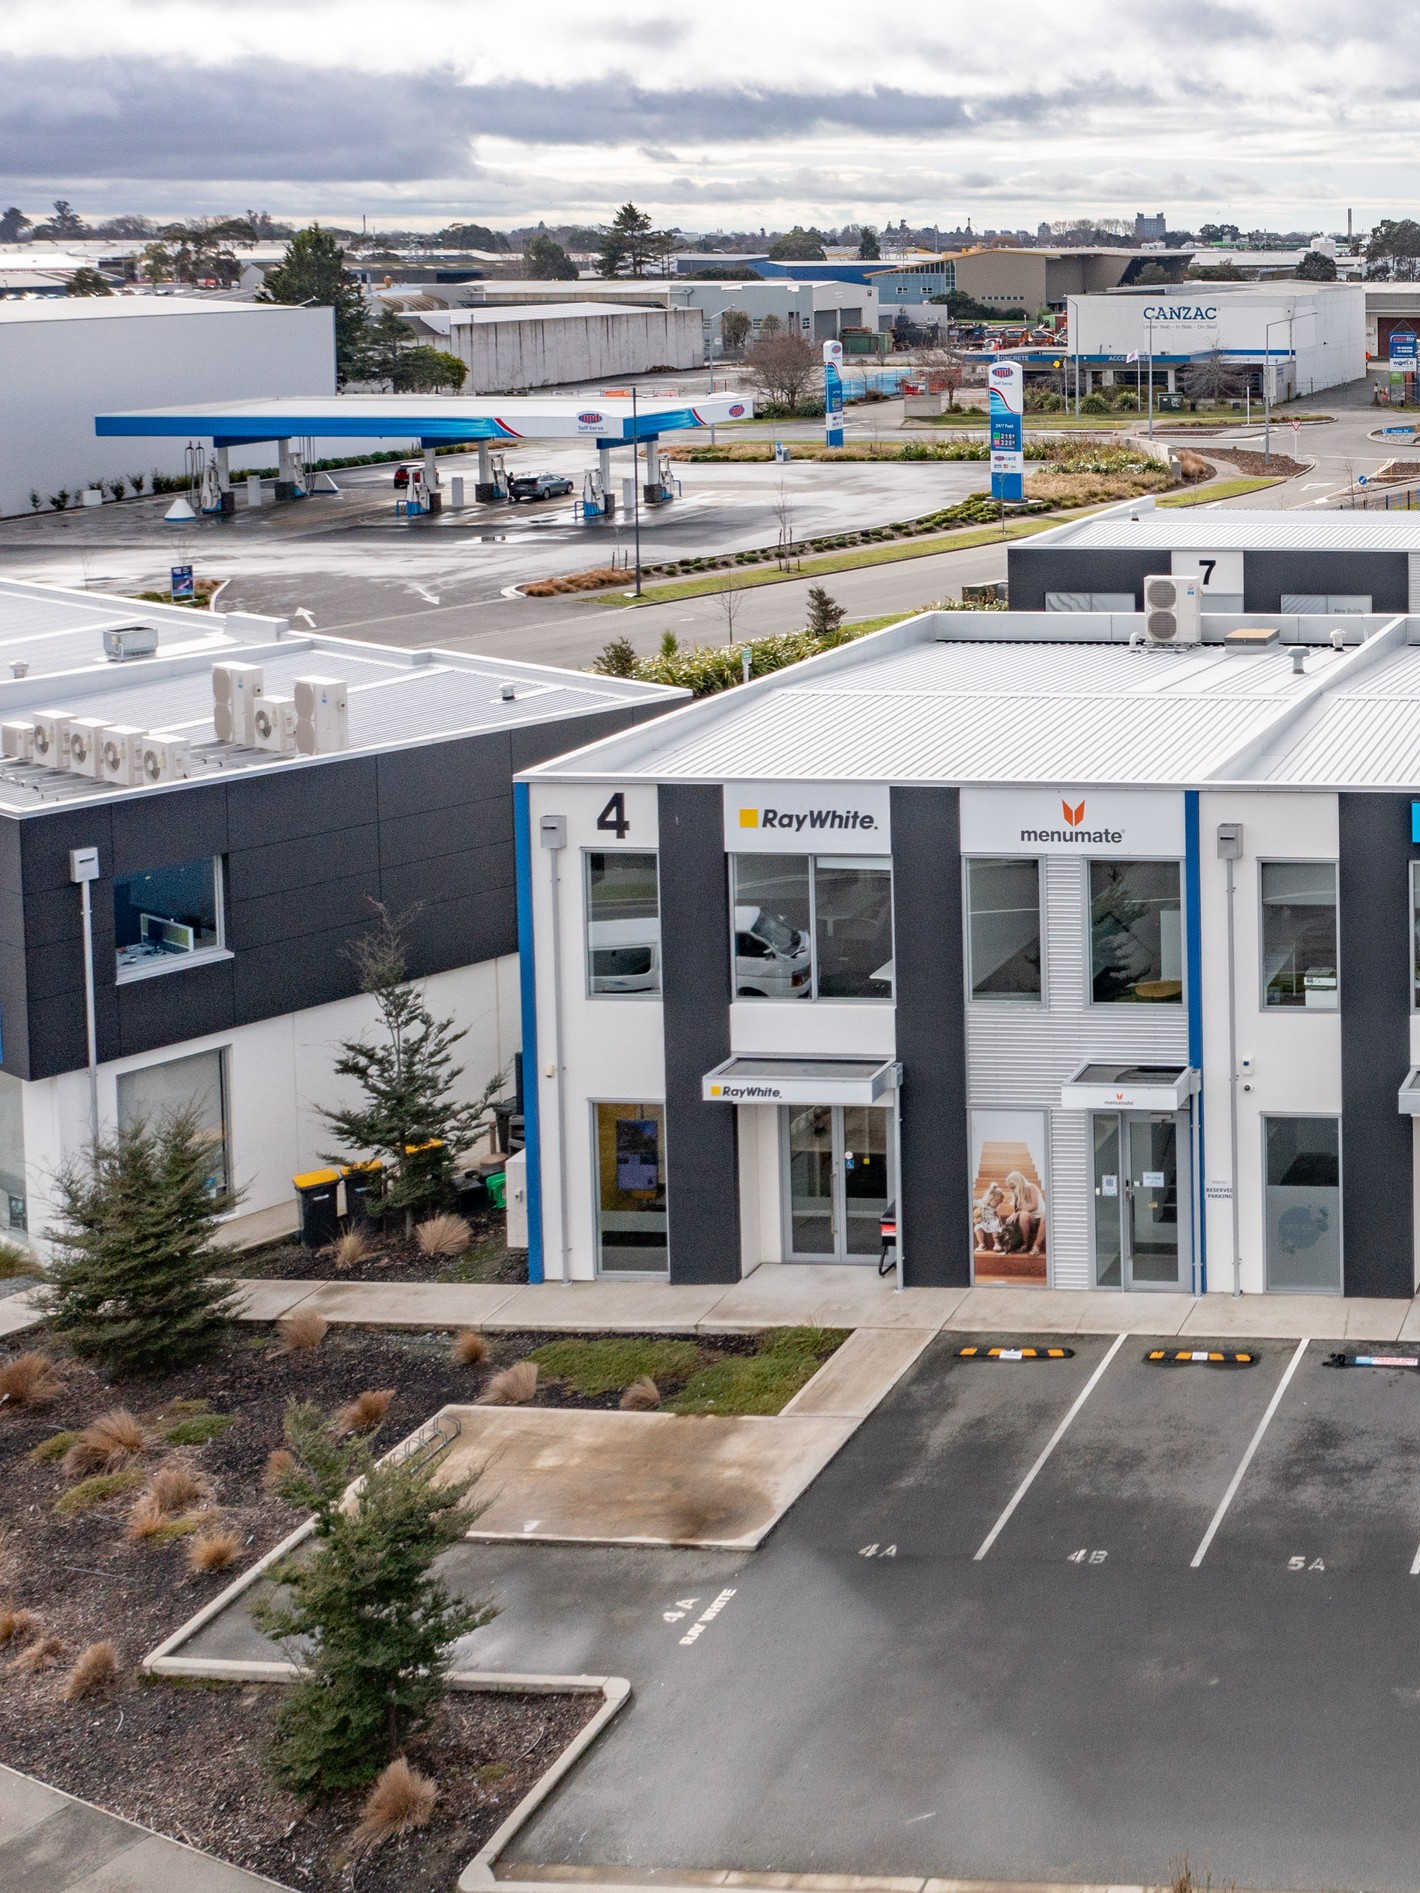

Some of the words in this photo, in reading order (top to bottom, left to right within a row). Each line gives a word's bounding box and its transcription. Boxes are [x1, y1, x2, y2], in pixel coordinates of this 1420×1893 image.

[1143, 306, 1217, 320] CANZAC
[1198, 559, 1216, 585] 7
[597, 792, 630, 839] 4
[1021, 828, 1123, 843] menumate
[698, 1588, 738, 1622] WHITE
